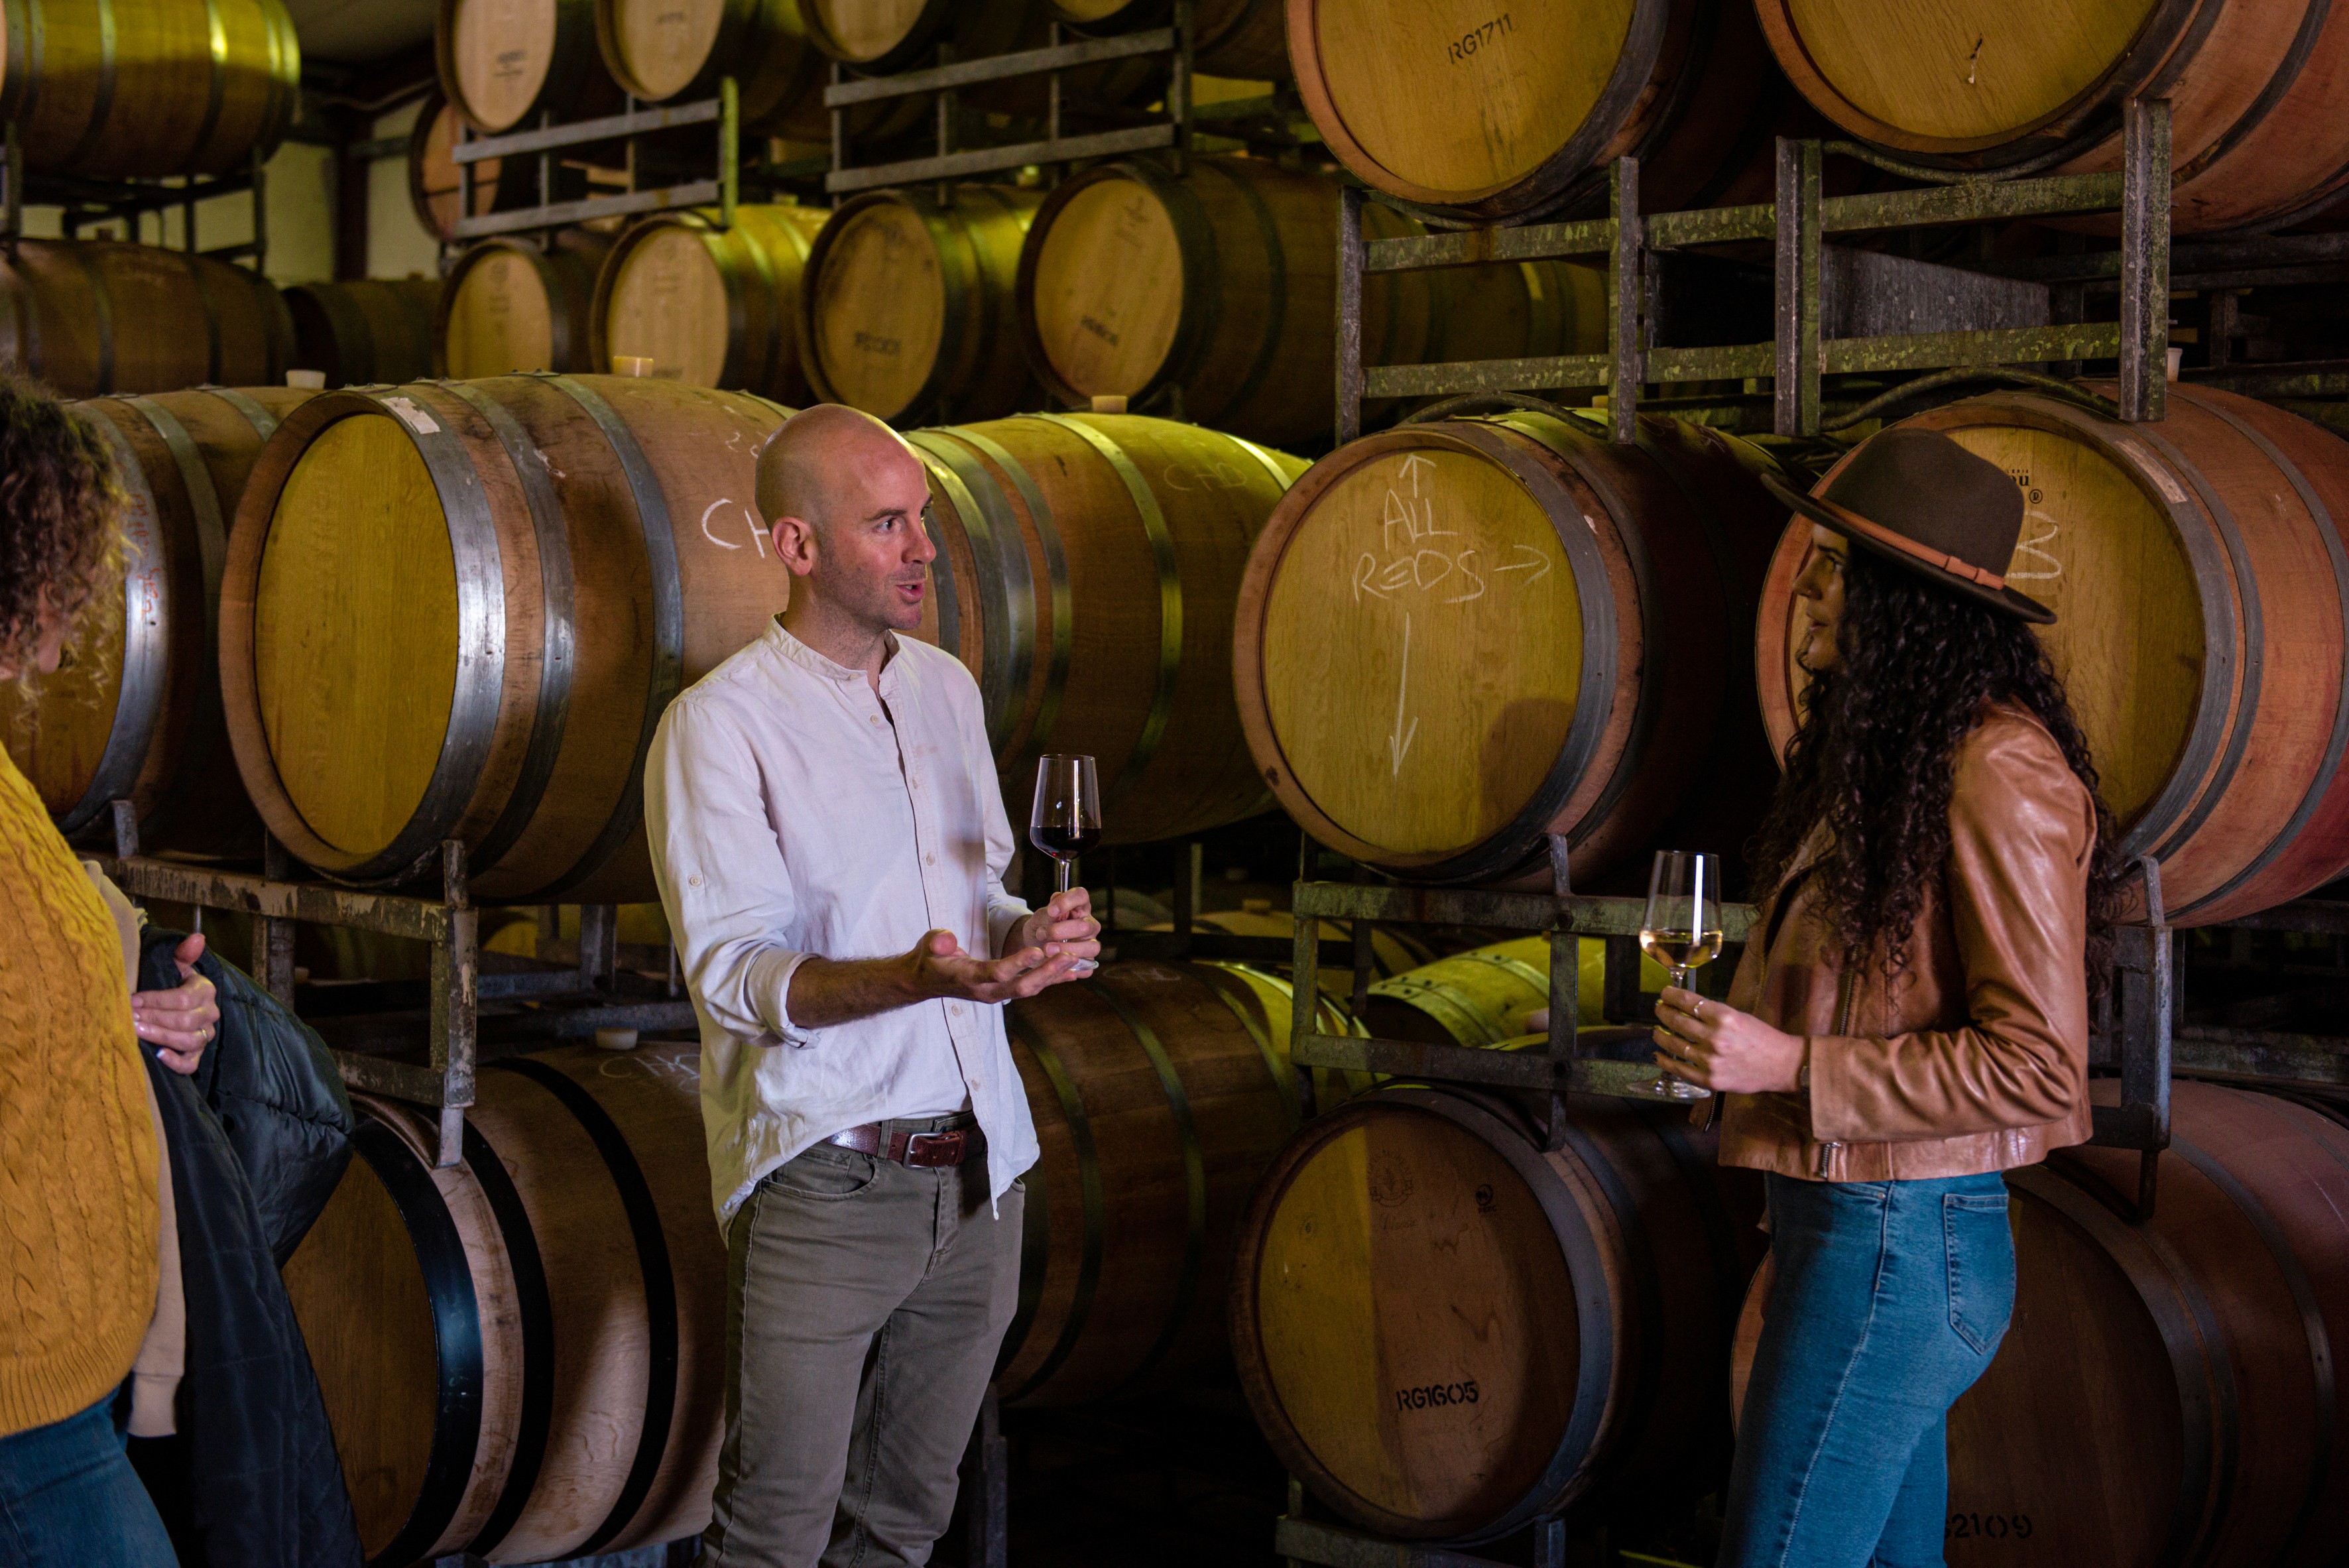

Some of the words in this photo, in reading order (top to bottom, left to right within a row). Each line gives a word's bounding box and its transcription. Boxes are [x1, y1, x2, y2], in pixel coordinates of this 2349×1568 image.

[1447, 12, 1513, 65] RG1711
[1384, 488, 1459, 552] ALL
[1352, 550, 1485, 603] REDS
[1945, 1512, 2033, 1539] 2109
